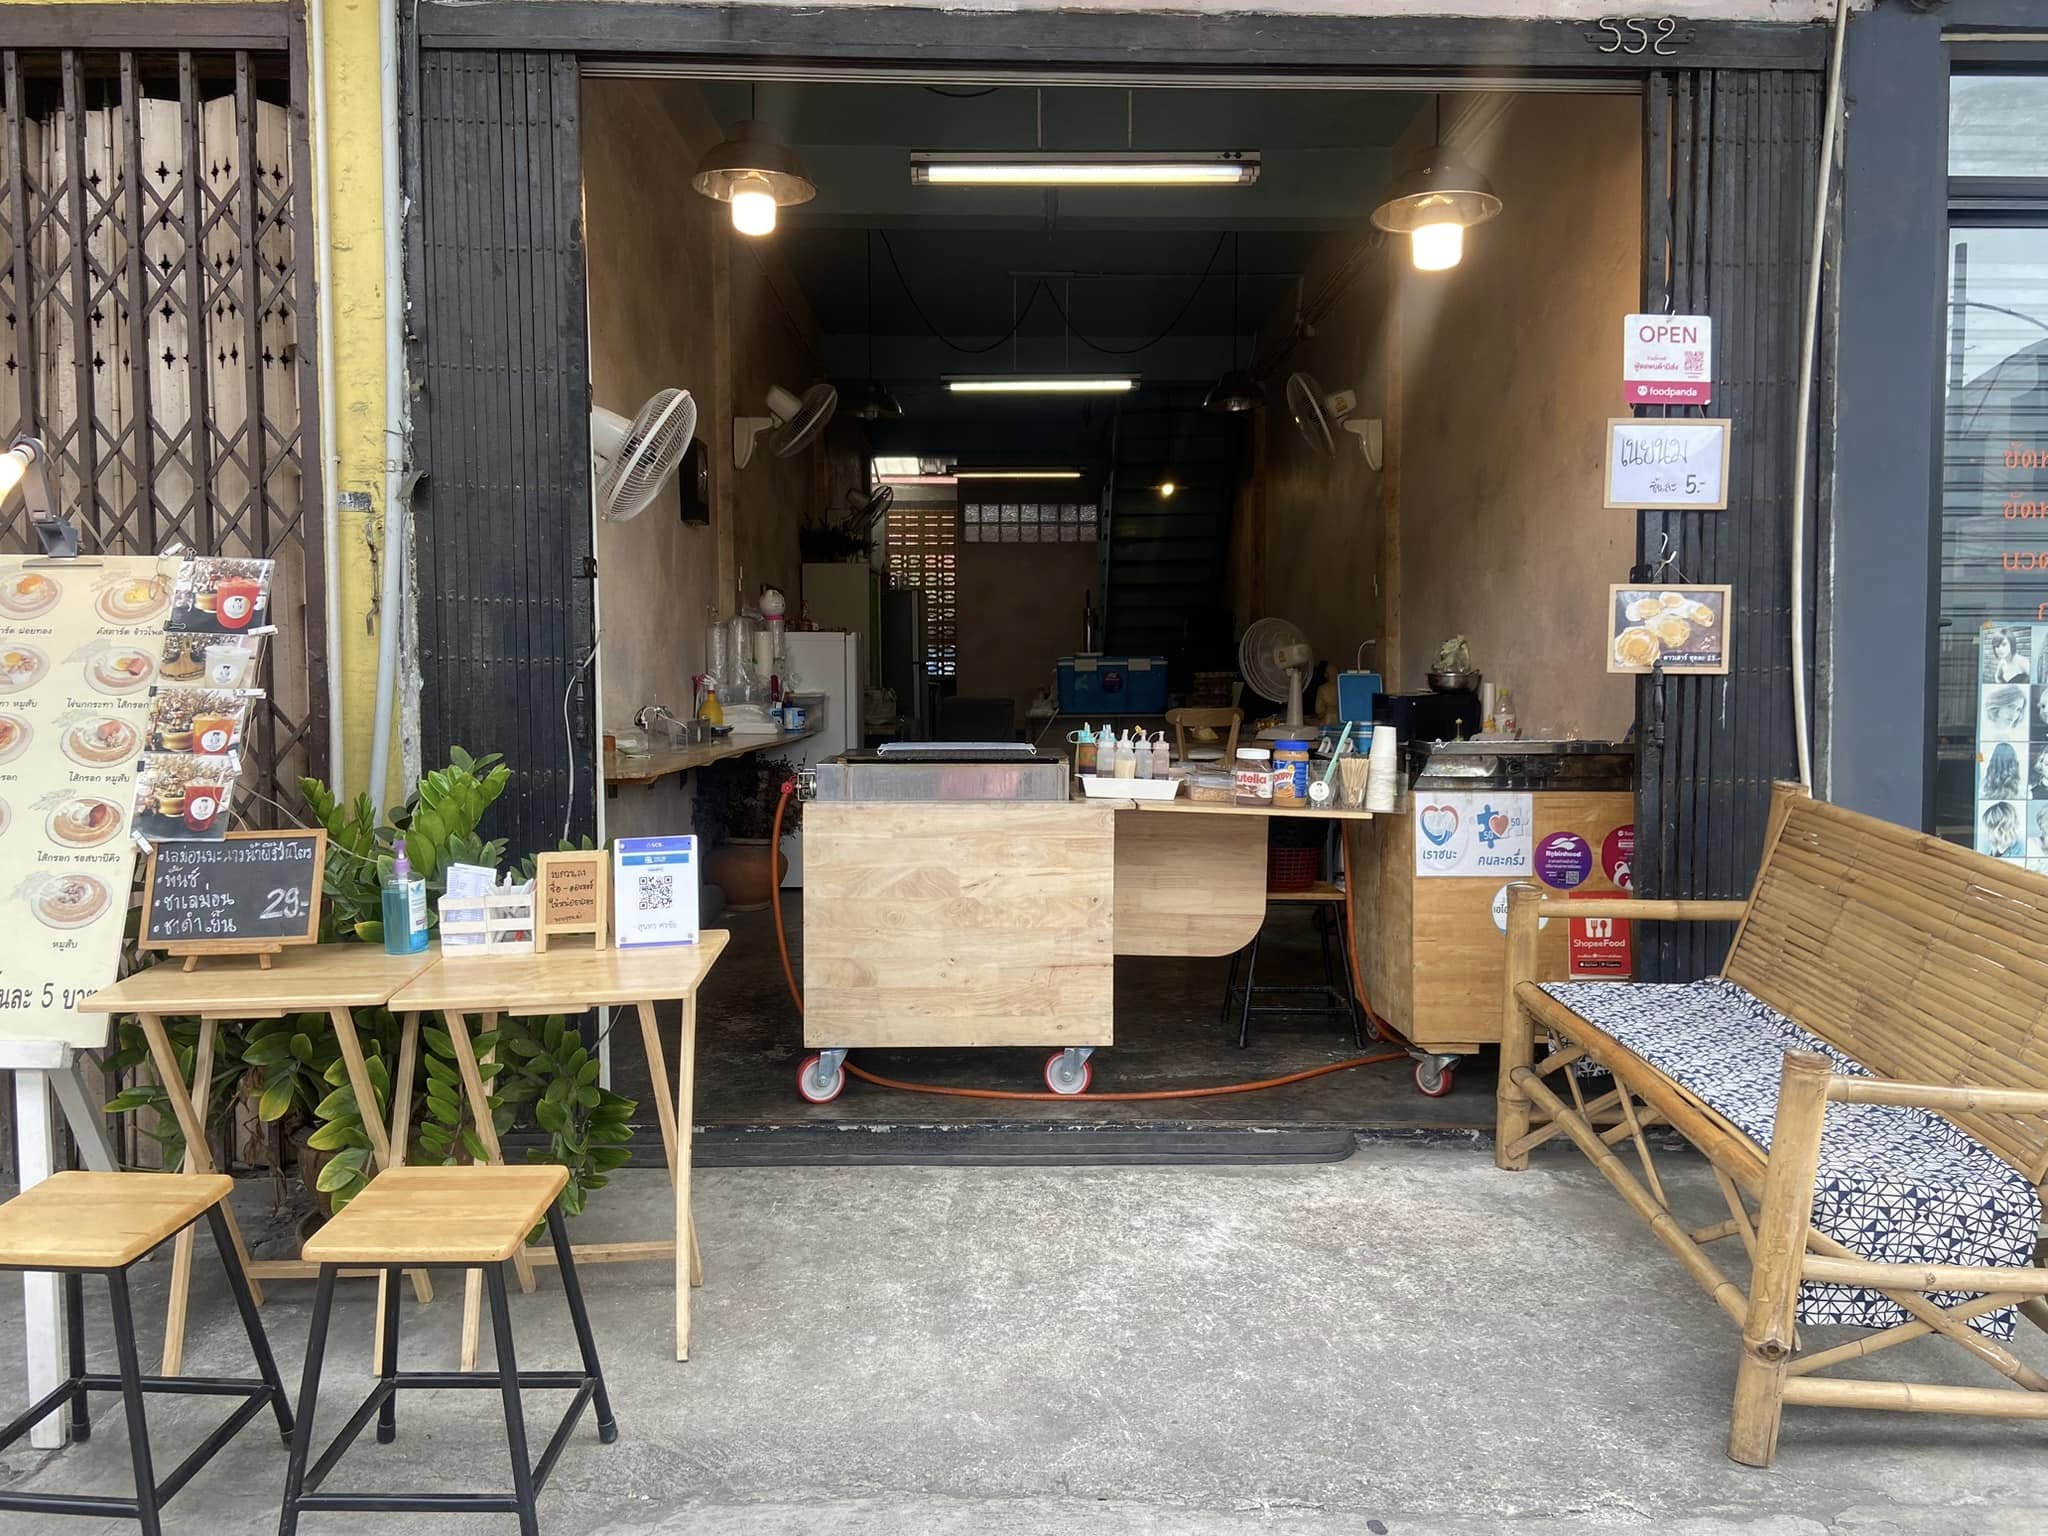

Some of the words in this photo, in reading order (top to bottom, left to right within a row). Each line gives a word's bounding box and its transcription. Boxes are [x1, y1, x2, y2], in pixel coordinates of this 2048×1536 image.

[1599, 17, 1677, 55] 552
[1639, 325, 1697, 343] OPEN
[1649, 386, 1697, 398] foodpanda
[1621, 437, 1688, 467] เนยนม
[1423, 848, 1458, 860] เราชนะ
[1478, 848, 1526, 866] คนละครึ่ง
[52, 939, 78, 952] หมูสับ
[1573, 938, 1626, 949] ShopeeFood
[41, 982, 55, 1008] 5
